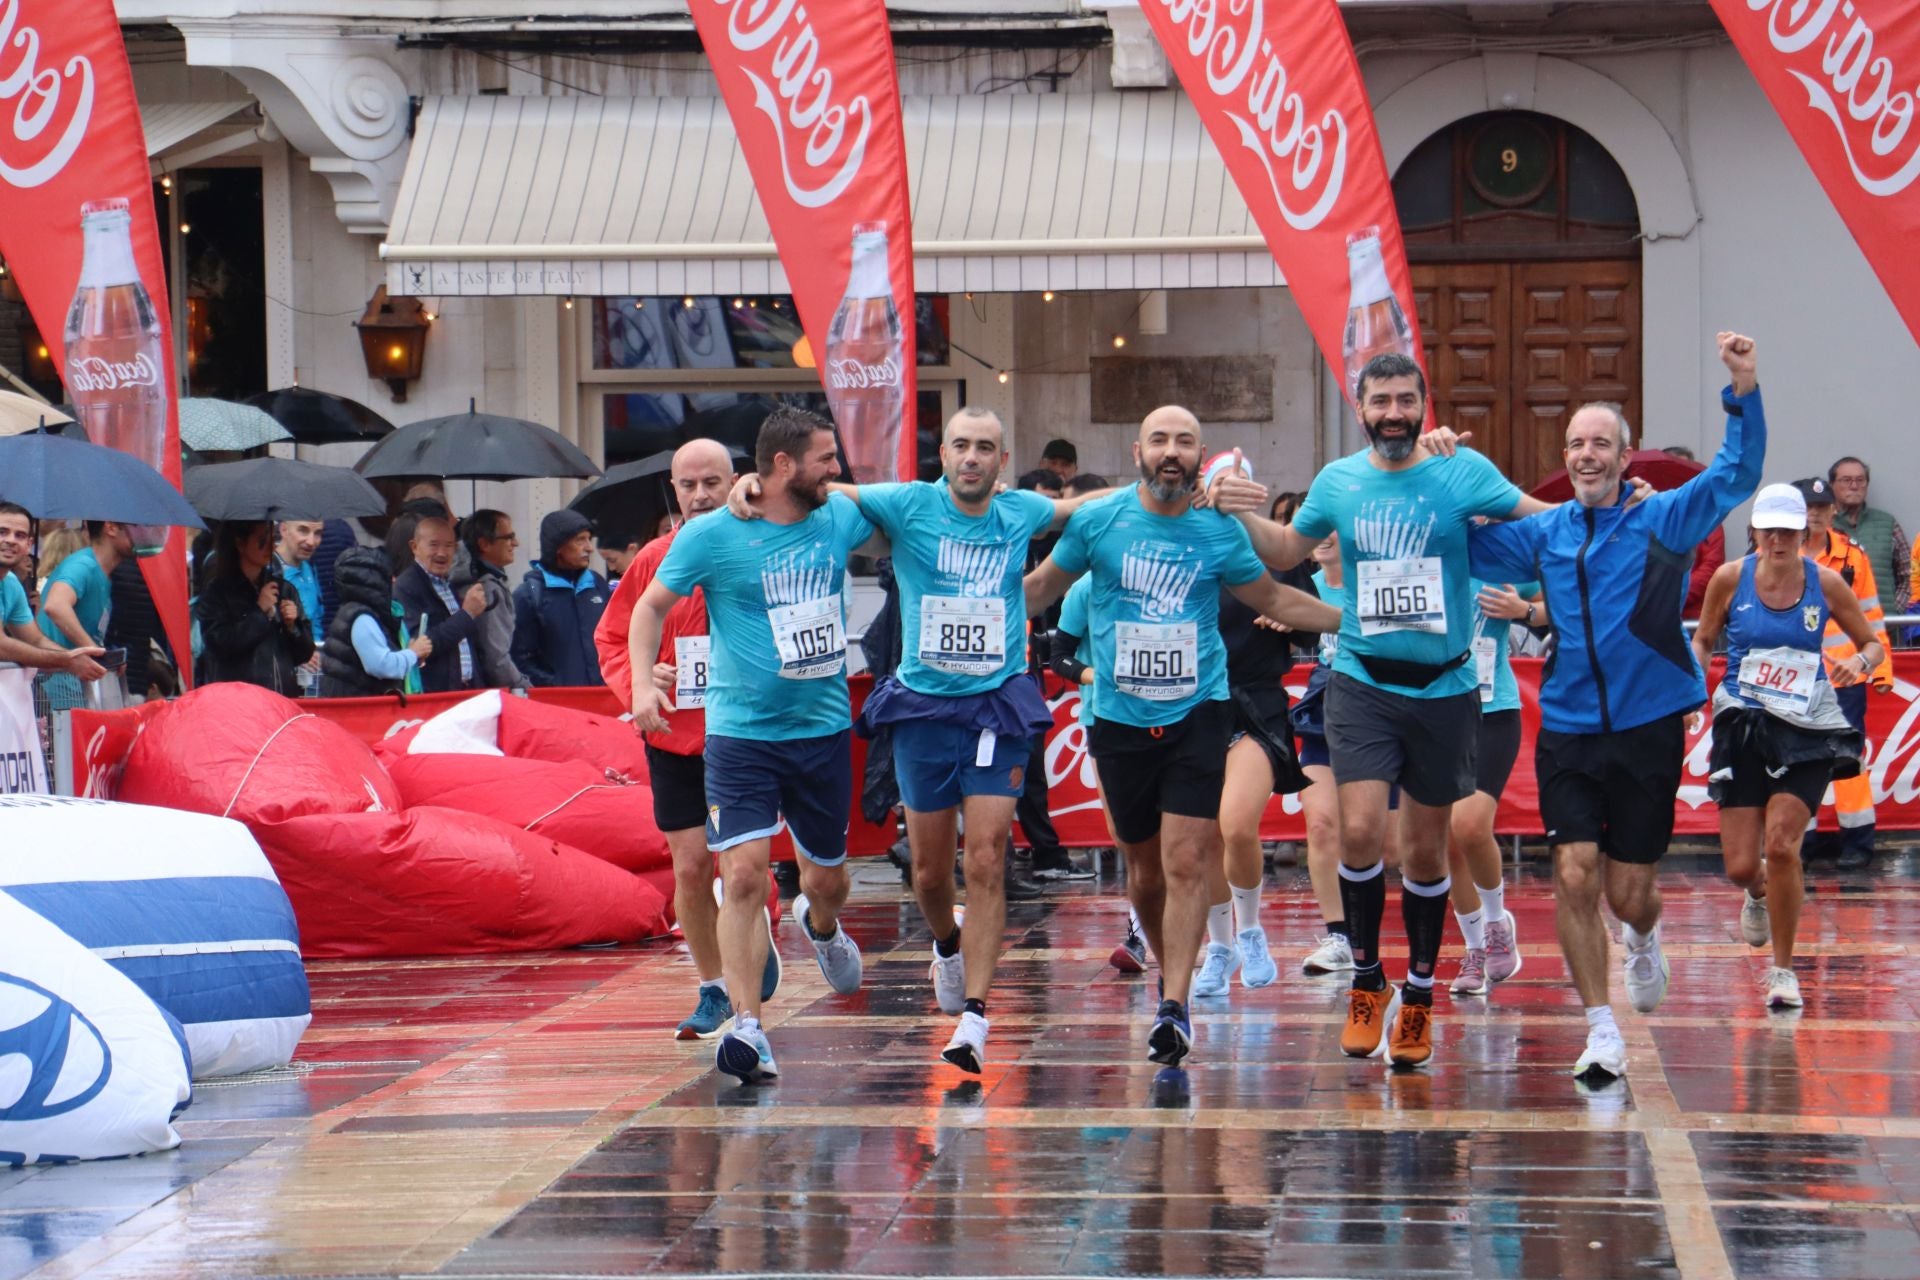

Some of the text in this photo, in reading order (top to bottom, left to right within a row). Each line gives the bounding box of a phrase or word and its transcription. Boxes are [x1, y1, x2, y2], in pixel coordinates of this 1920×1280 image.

[1502, 149, 1517, 172] 9
[437, 271, 585, 285] A TASTE OF ITALY
[1374, 585, 1427, 615] 1056
[792, 623, 835, 659] 1057
[940, 624, 986, 652] 893
[950, 663, 991, 671] HYUNDAI
[1131, 649, 1182, 677] 1050
[1755, 662, 1798, 692] 942
[1145, 687, 1184, 695] HYUNDAI
